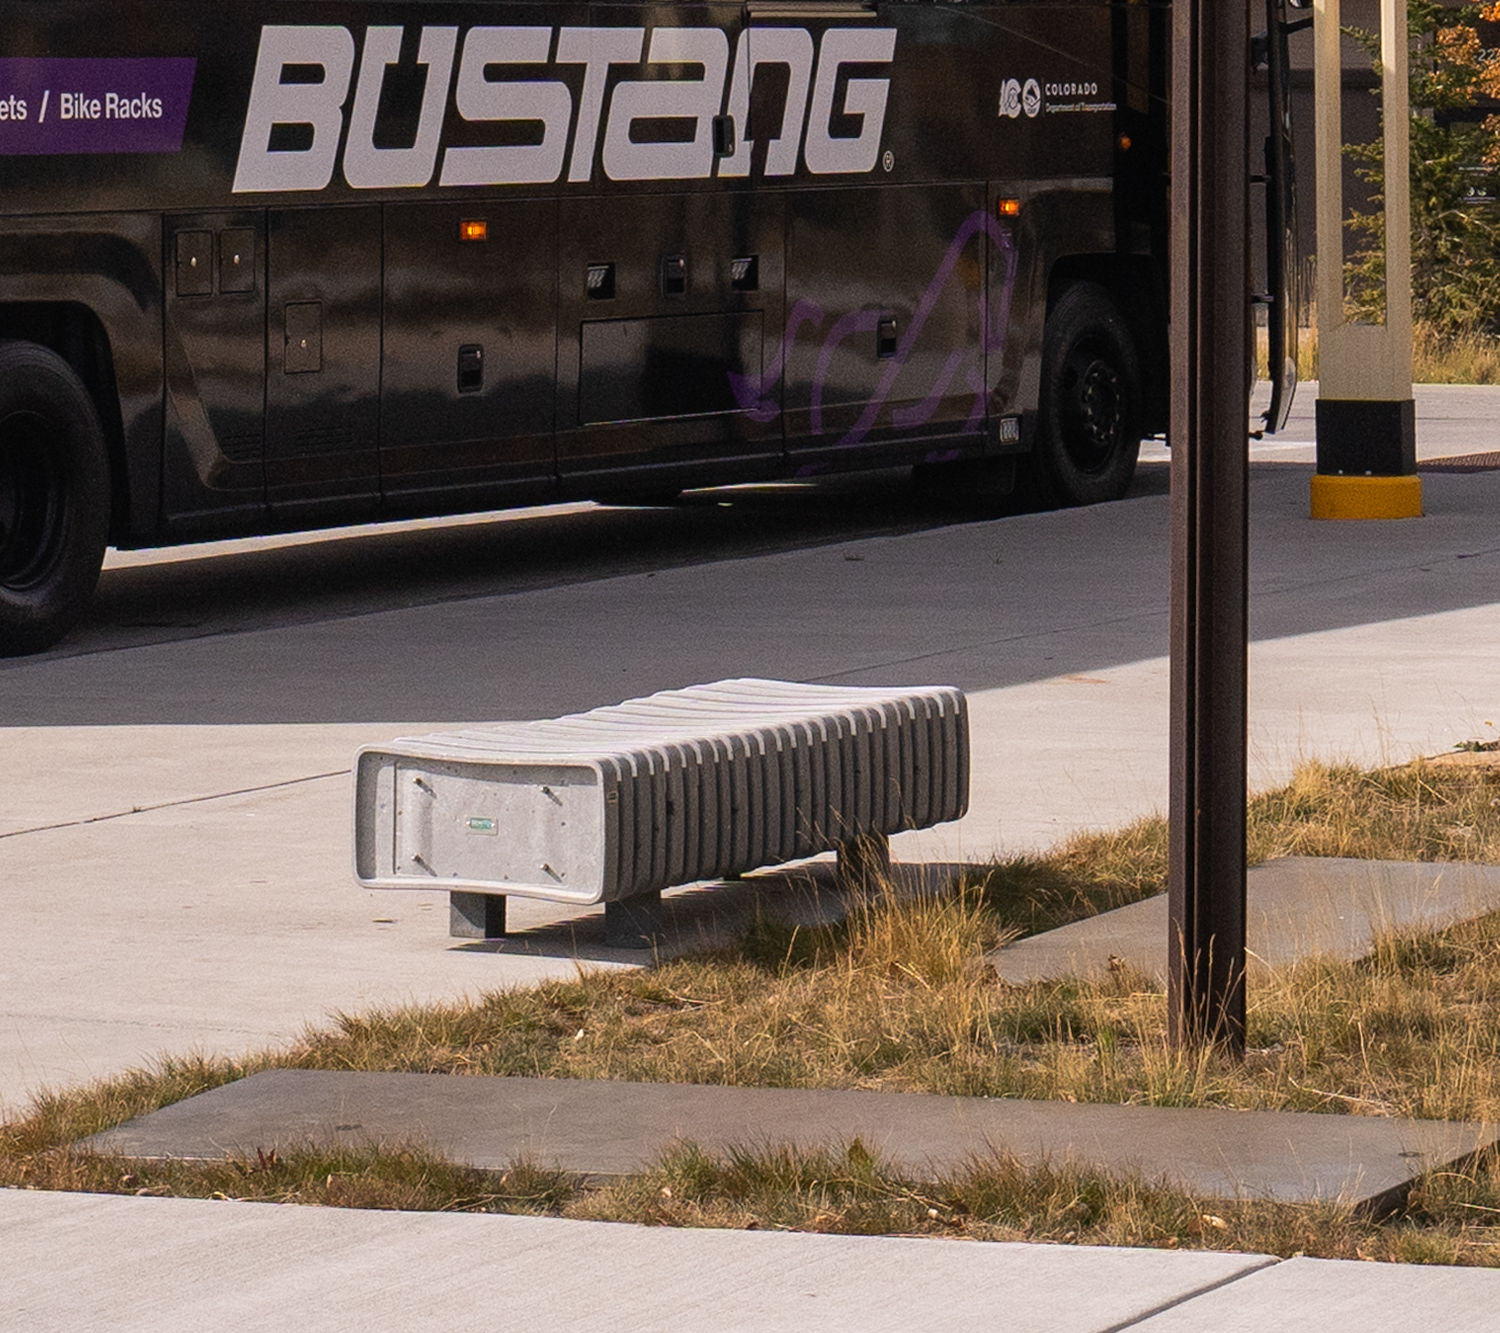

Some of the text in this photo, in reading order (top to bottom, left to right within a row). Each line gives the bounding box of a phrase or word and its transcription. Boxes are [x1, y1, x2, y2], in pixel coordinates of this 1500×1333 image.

[1045, 83, 1098, 96] COLORADO
[60, 92, 101, 120] Bike
[105, 92, 163, 120] Racks
